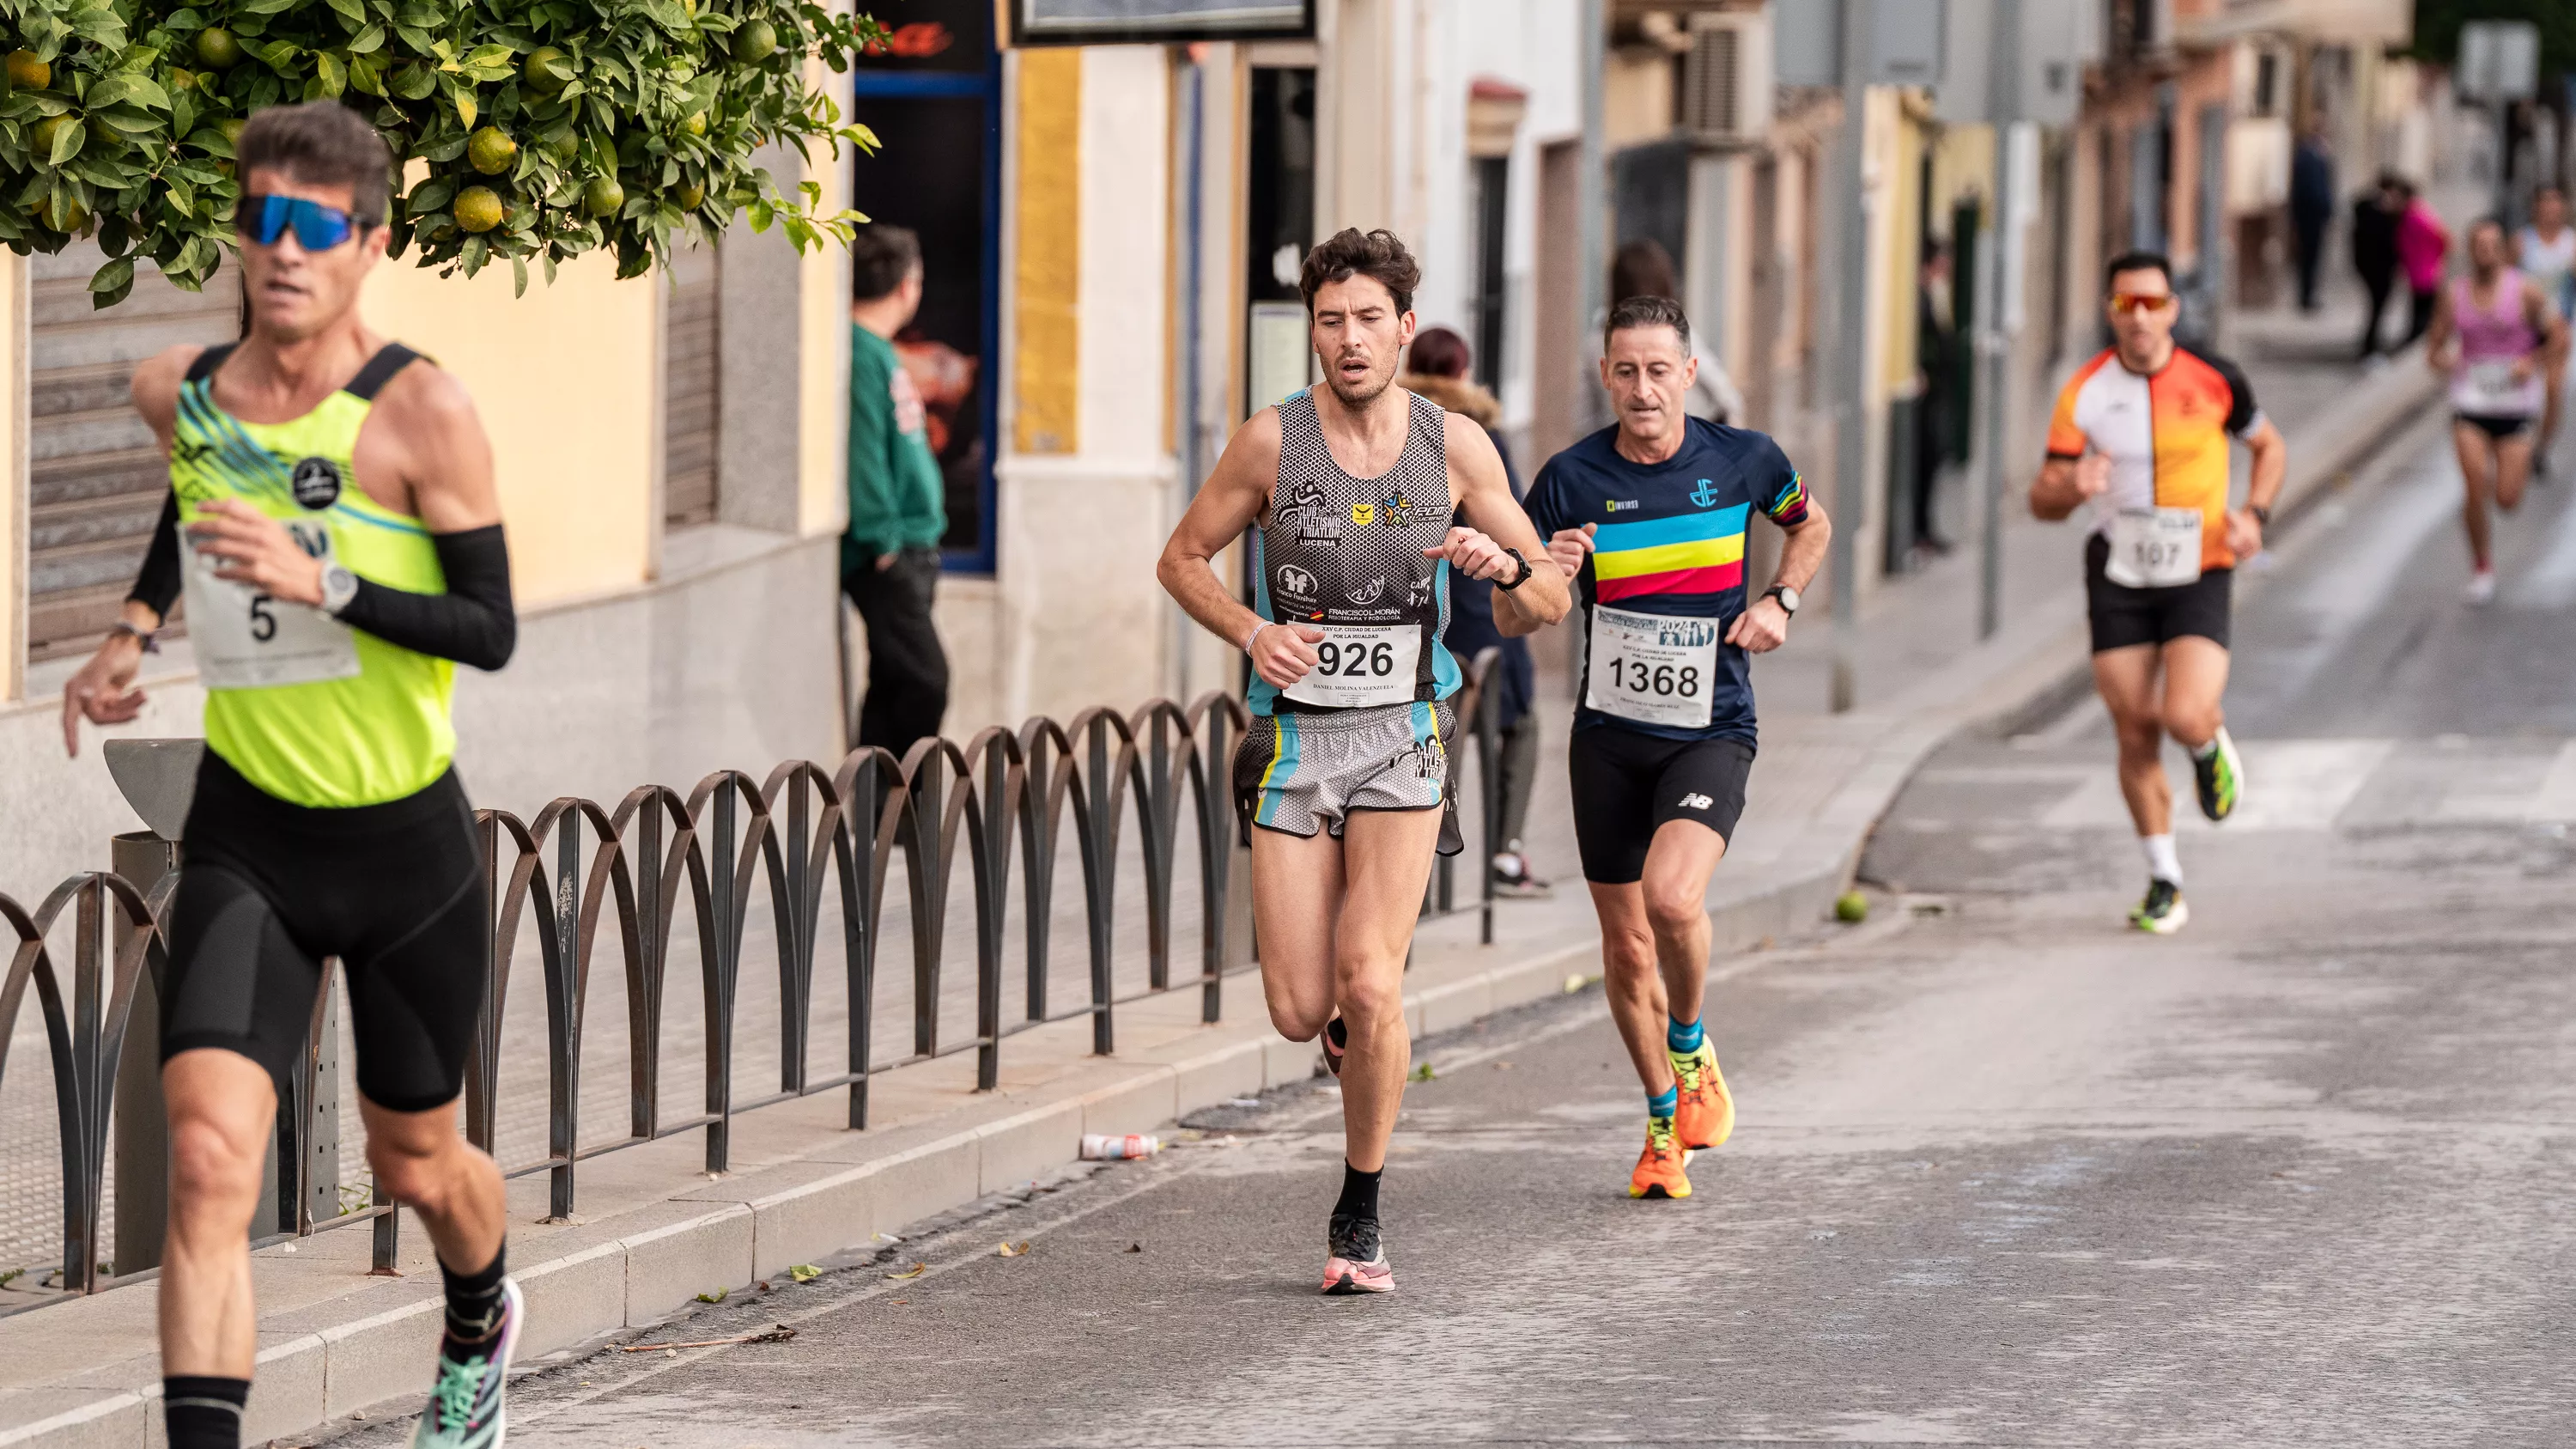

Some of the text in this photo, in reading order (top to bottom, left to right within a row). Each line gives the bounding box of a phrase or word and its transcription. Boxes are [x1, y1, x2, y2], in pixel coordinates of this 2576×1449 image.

[1297, 505, 1317, 517] CLUB
[1297, 515, 1340, 527] ATLETISMO
[1297, 526, 1340, 538] Y TRIATLON
[1299, 539, 1336, 547] LUCENA
[250, 594, 277, 642] 5
[1317, 642, 1394, 677] 926
[1609, 656, 1698, 697] 1368
